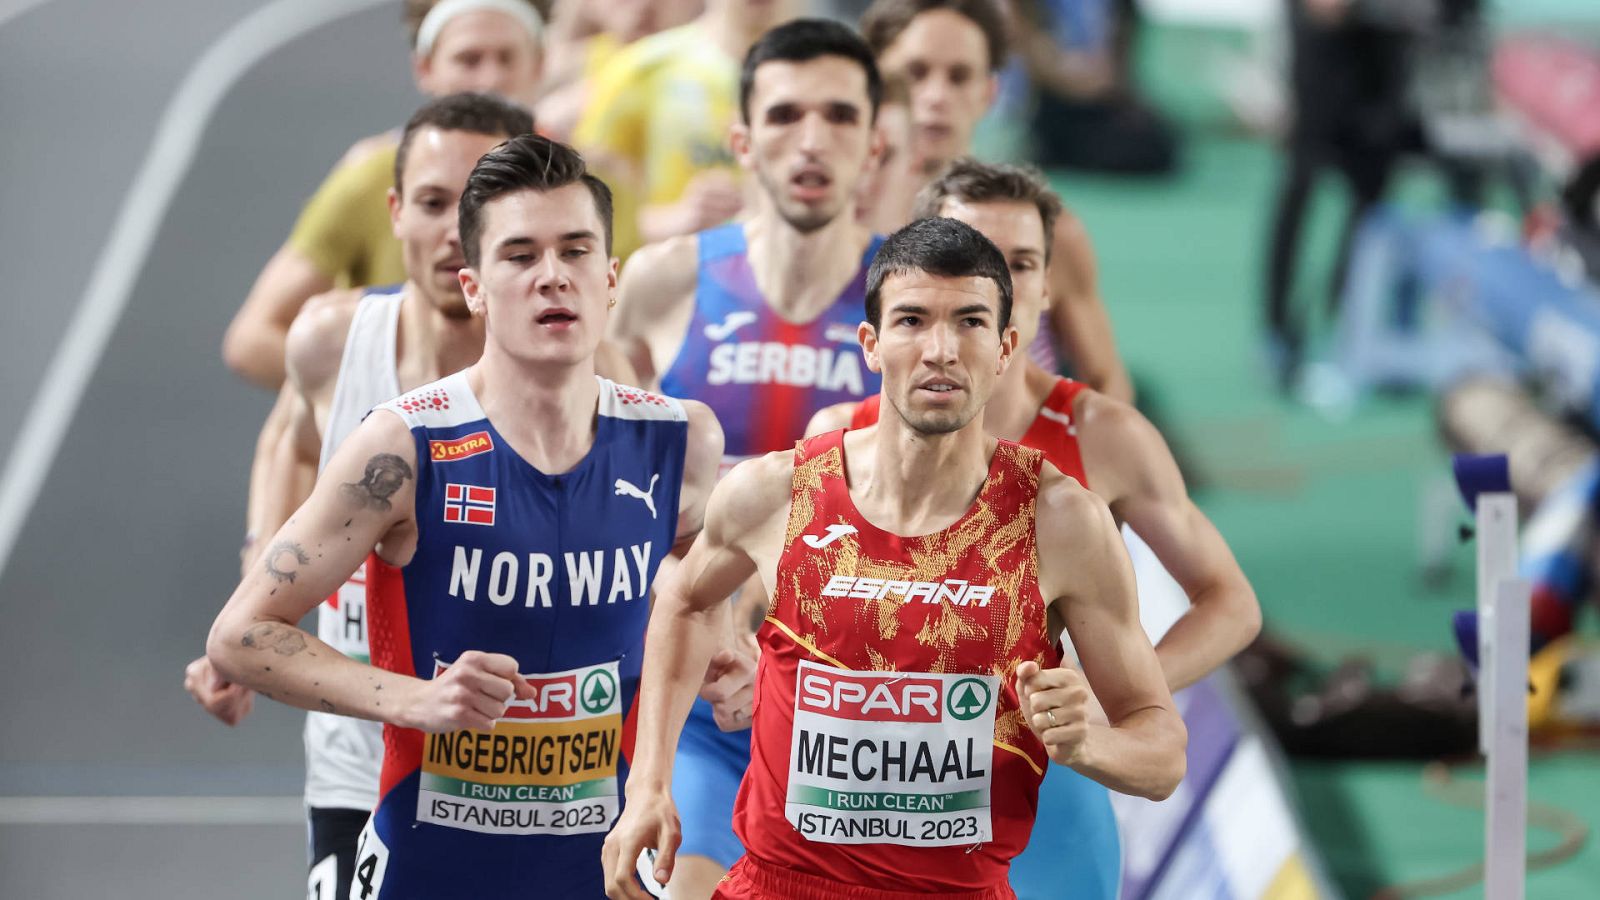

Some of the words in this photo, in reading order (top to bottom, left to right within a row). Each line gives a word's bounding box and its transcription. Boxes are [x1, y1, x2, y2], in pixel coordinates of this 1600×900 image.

[707, 342, 864, 395] SERBIA
[448, 437, 487, 455] EXTRA
[448, 541, 652, 607] NORWAY
[821, 574, 996, 608] ESPAÑA
[802, 674, 938, 717] SPAR
[429, 729, 615, 775] INGEBRIGTSEN
[797, 729, 986, 783] MECHAAL
[461, 782, 467, 795] I
[471, 783, 511, 800] RUN
[828, 792, 833, 806] I
[837, 794, 877, 809] RUN
[430, 799, 545, 828] ISTANBUL
[551, 804, 606, 828] 2023
[797, 812, 916, 840] ISTANBUL
[920, 816, 978, 841] 2023
